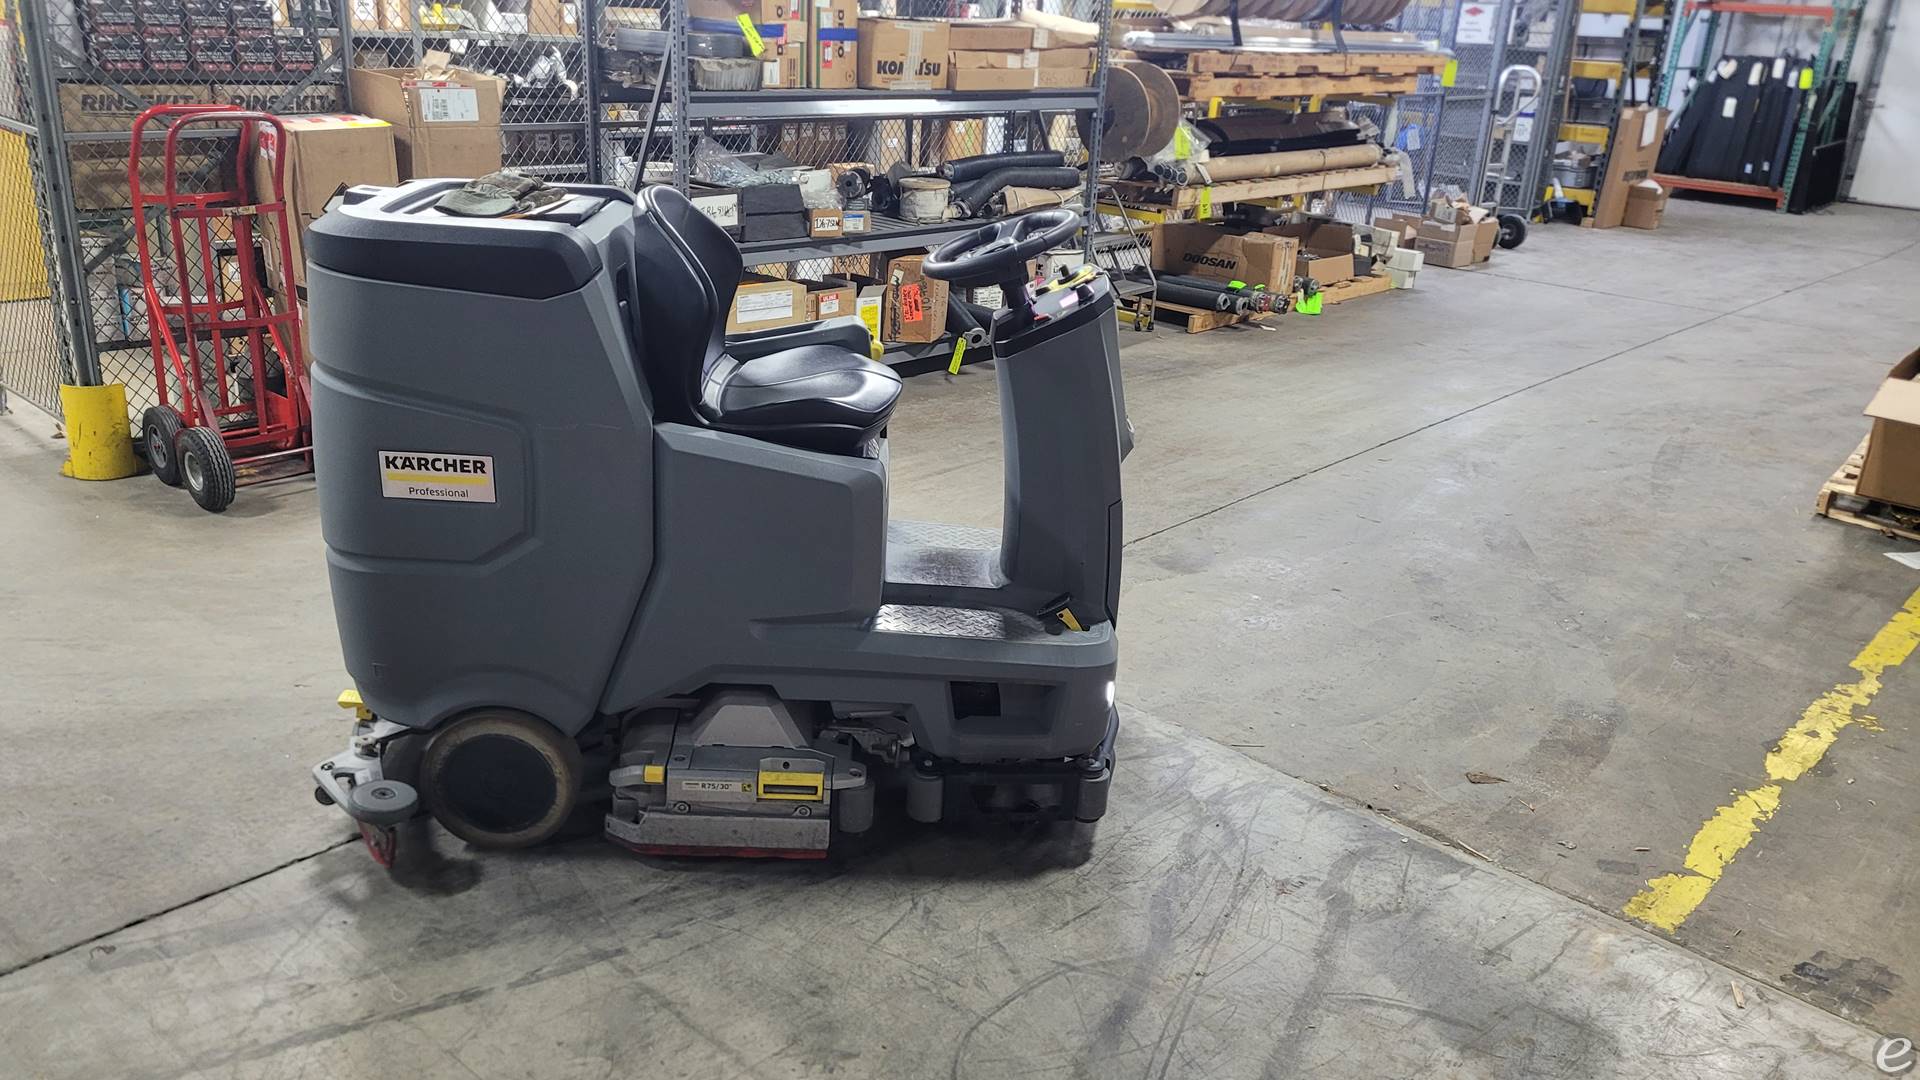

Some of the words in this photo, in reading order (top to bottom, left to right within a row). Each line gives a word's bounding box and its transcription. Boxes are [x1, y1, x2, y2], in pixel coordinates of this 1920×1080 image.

[1182, 252, 1237, 271] DOOSAN
[384, 455, 487, 475] KÄRCHER
[408, 487, 469, 498] Professional
